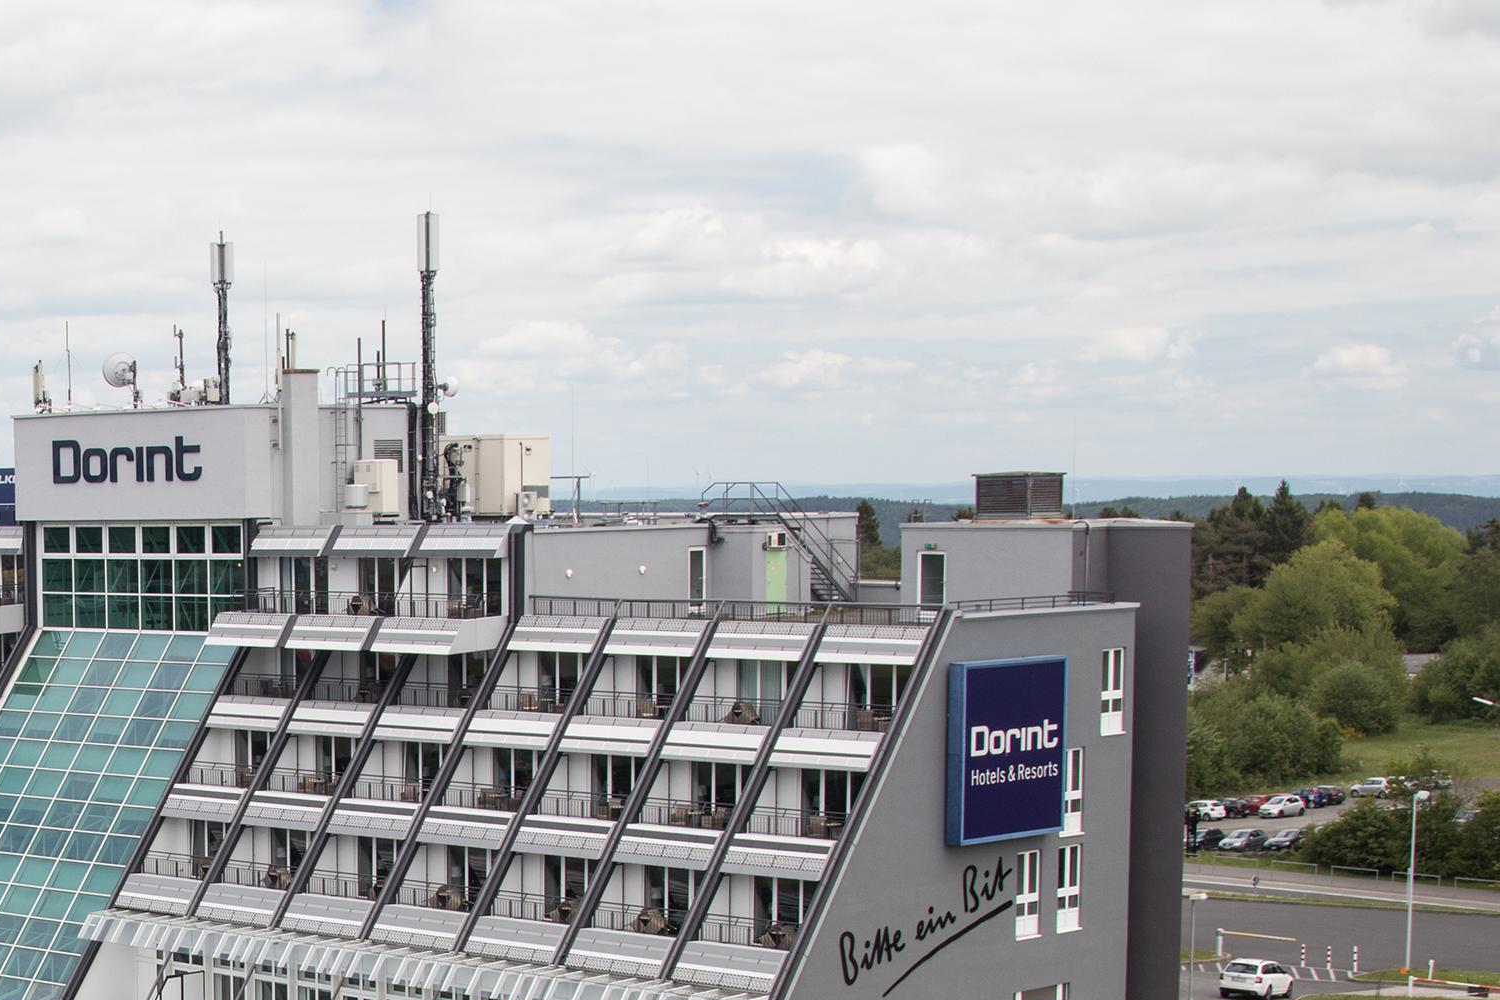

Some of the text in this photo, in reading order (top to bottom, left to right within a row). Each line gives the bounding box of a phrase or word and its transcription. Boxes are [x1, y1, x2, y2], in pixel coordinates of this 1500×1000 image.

[52, 436, 202, 484] Dorint
[970, 719, 1058, 757] Dorint
[971, 761, 1059, 786] Hotels & Resorts
[840, 856, 1012, 986] Bitte ein Bit
